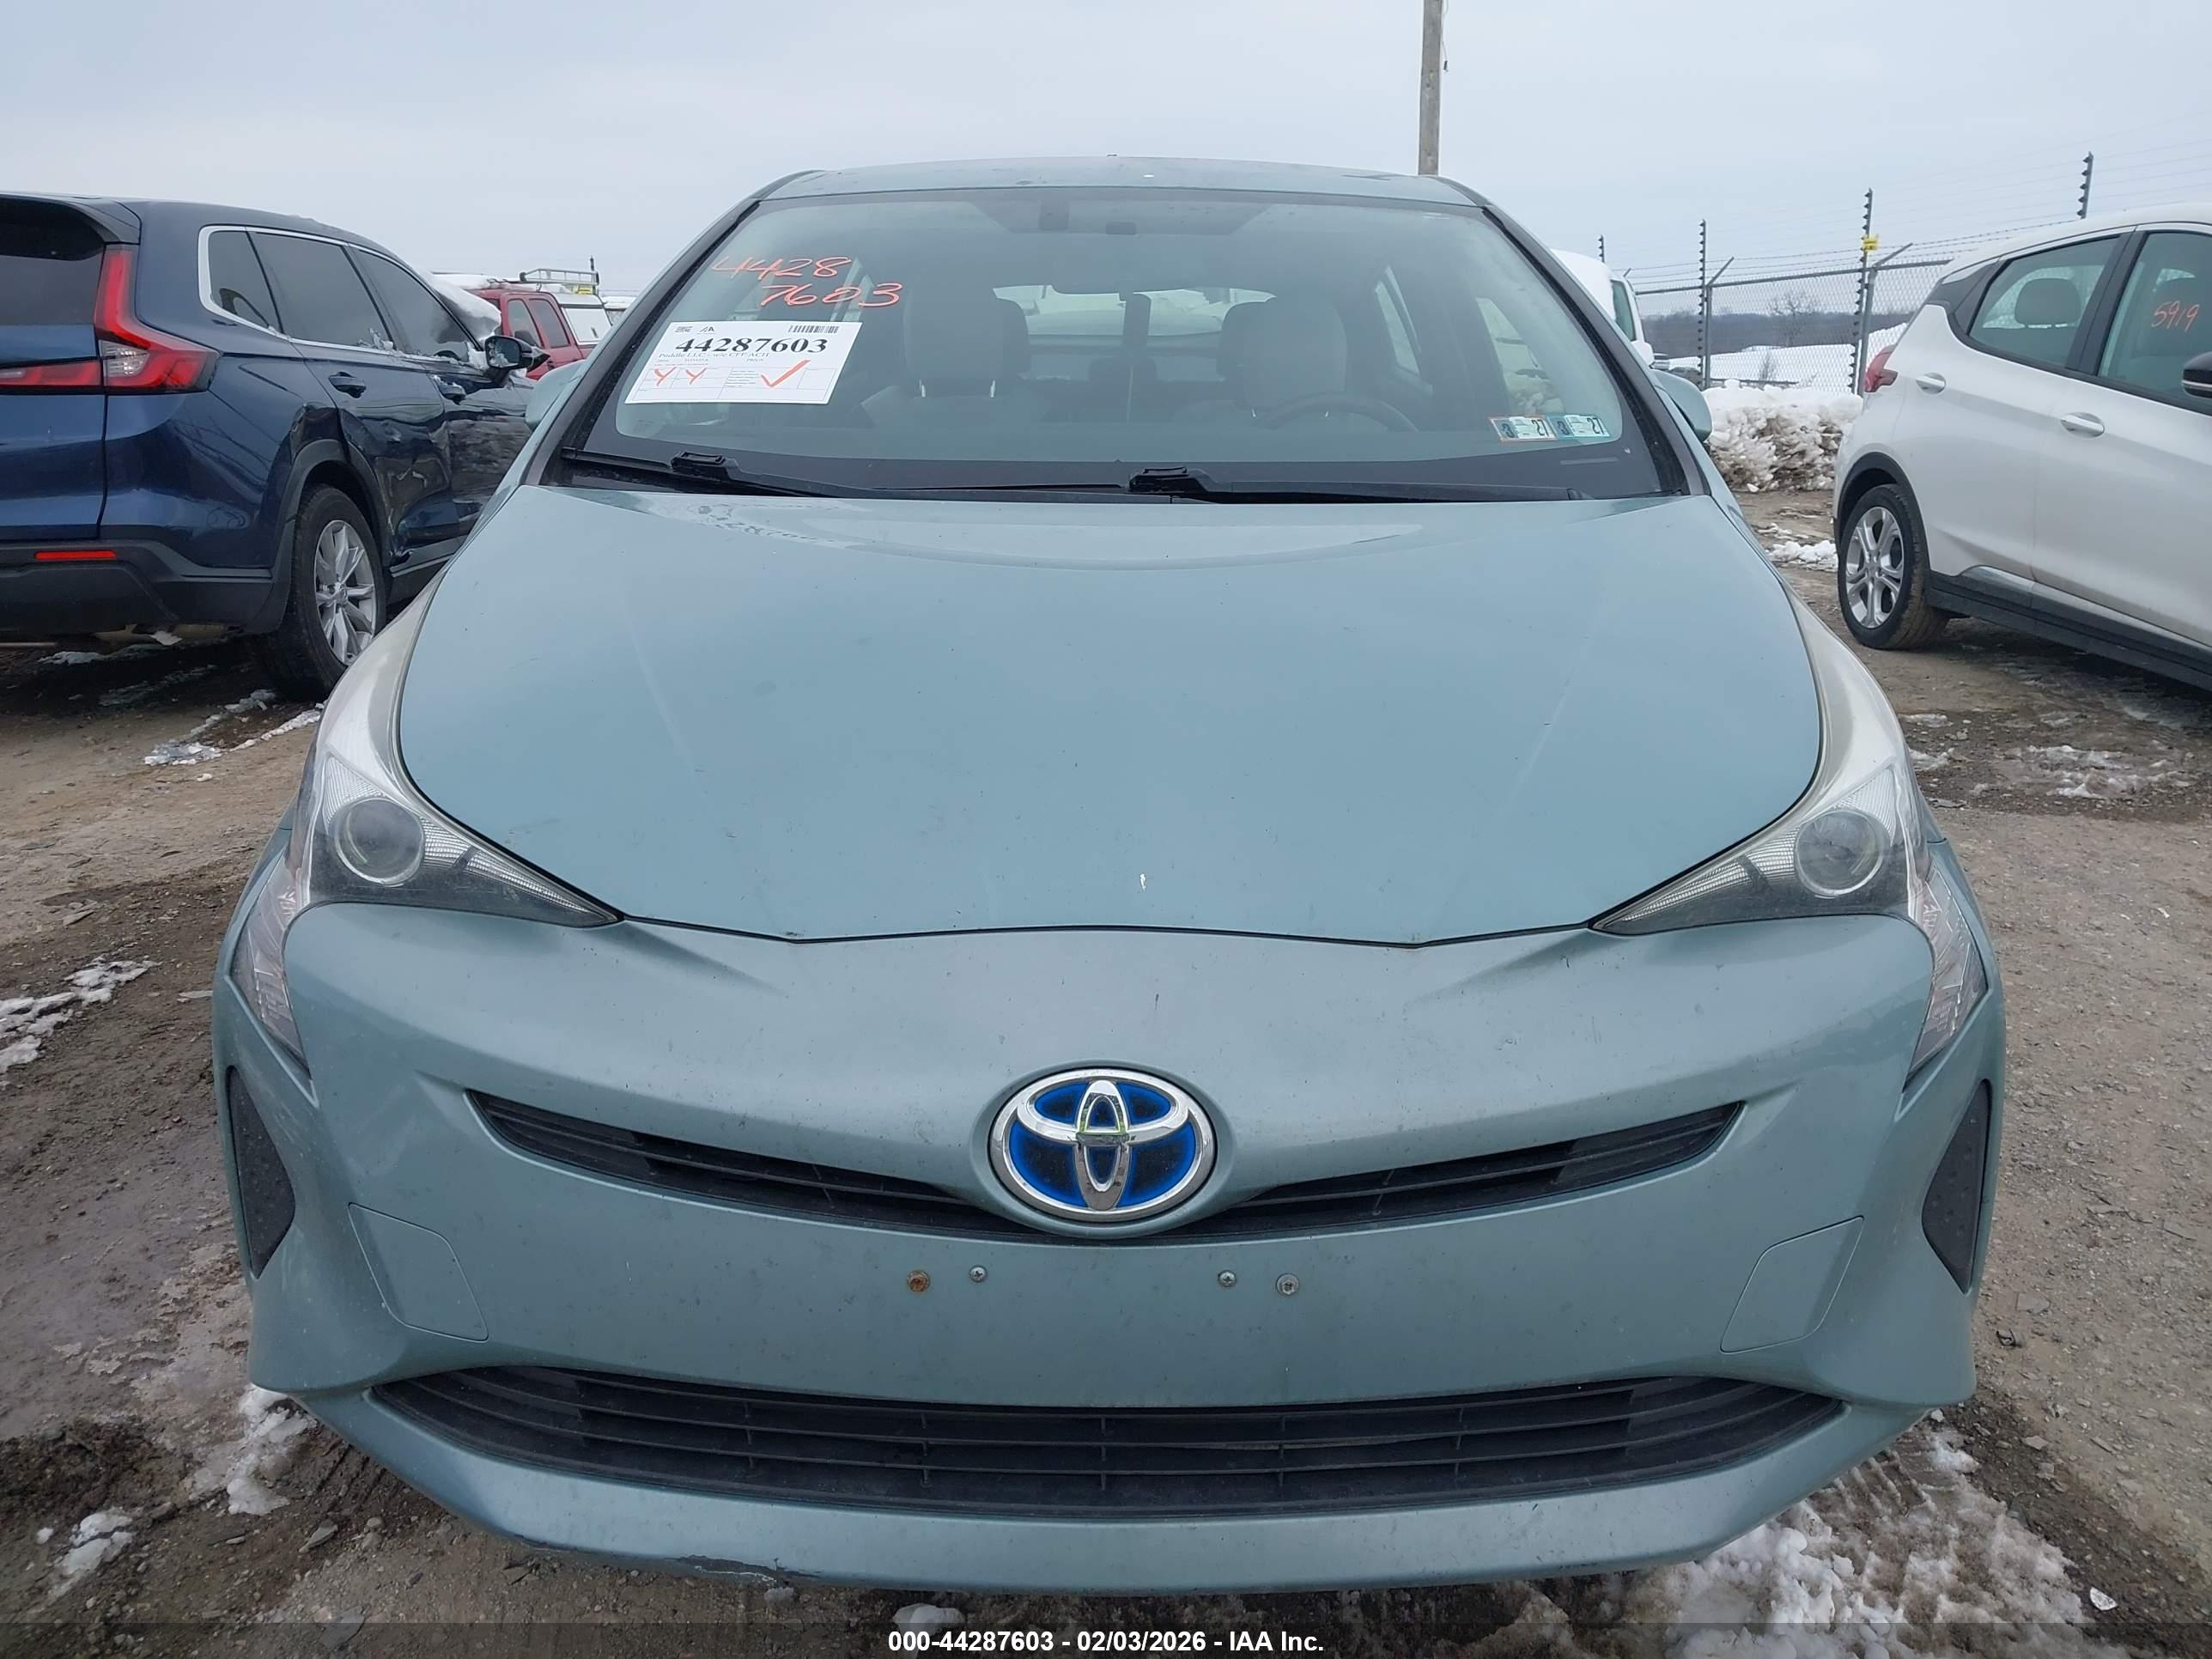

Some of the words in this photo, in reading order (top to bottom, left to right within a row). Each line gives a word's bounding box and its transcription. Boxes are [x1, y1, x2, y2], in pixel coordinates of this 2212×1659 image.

[712, 257, 852, 281] 4428
[760, 283, 903, 307] 7603
[2151, 301, 2200, 332] 5919
[675, 337, 828, 354] 44287603
[1501, 422, 1515, 438] 3
[1531, 419, 1550, 437] 27
[1557, 420, 1570, 436] 3
[1588, 417, 1605, 436] 27
